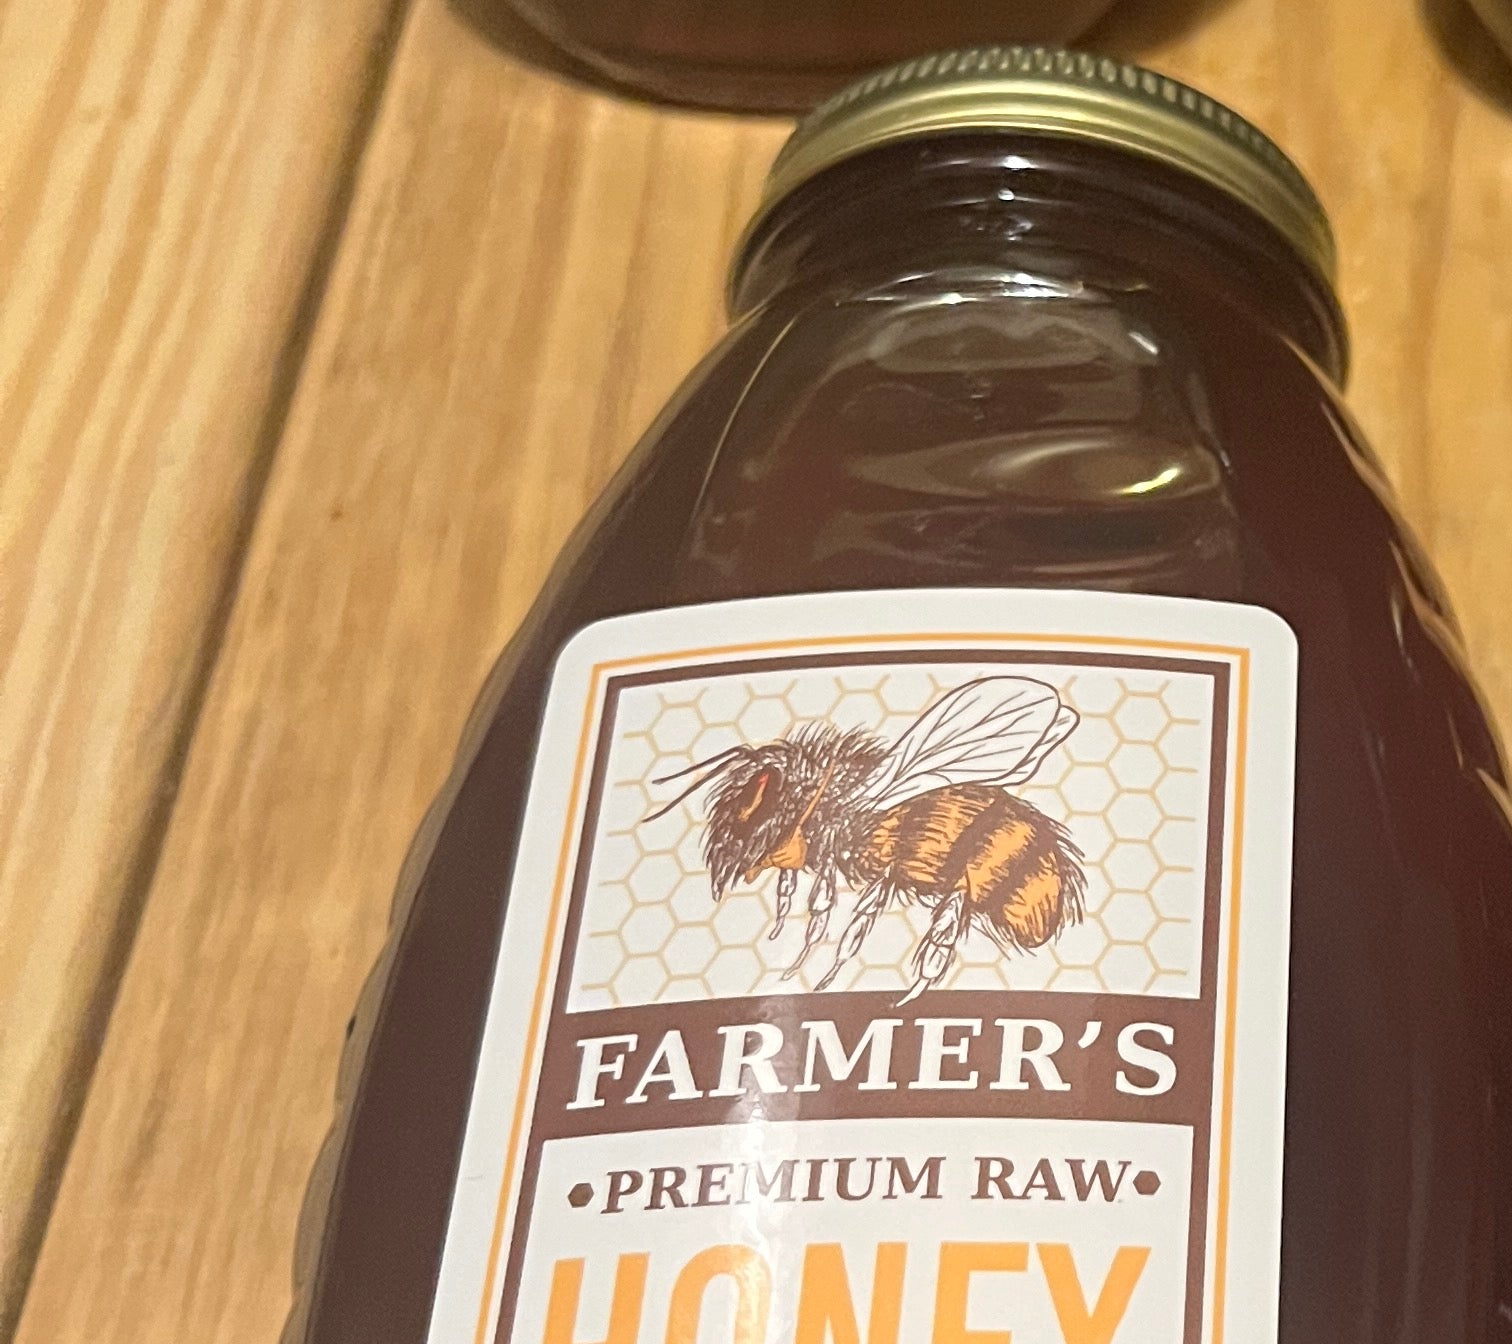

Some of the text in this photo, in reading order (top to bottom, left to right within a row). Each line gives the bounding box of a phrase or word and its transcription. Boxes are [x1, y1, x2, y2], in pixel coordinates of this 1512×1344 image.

[566, 1016, 1177, 1110] FARMER'S
[600, 1157, 1132, 1214] PREMIUM RAW
